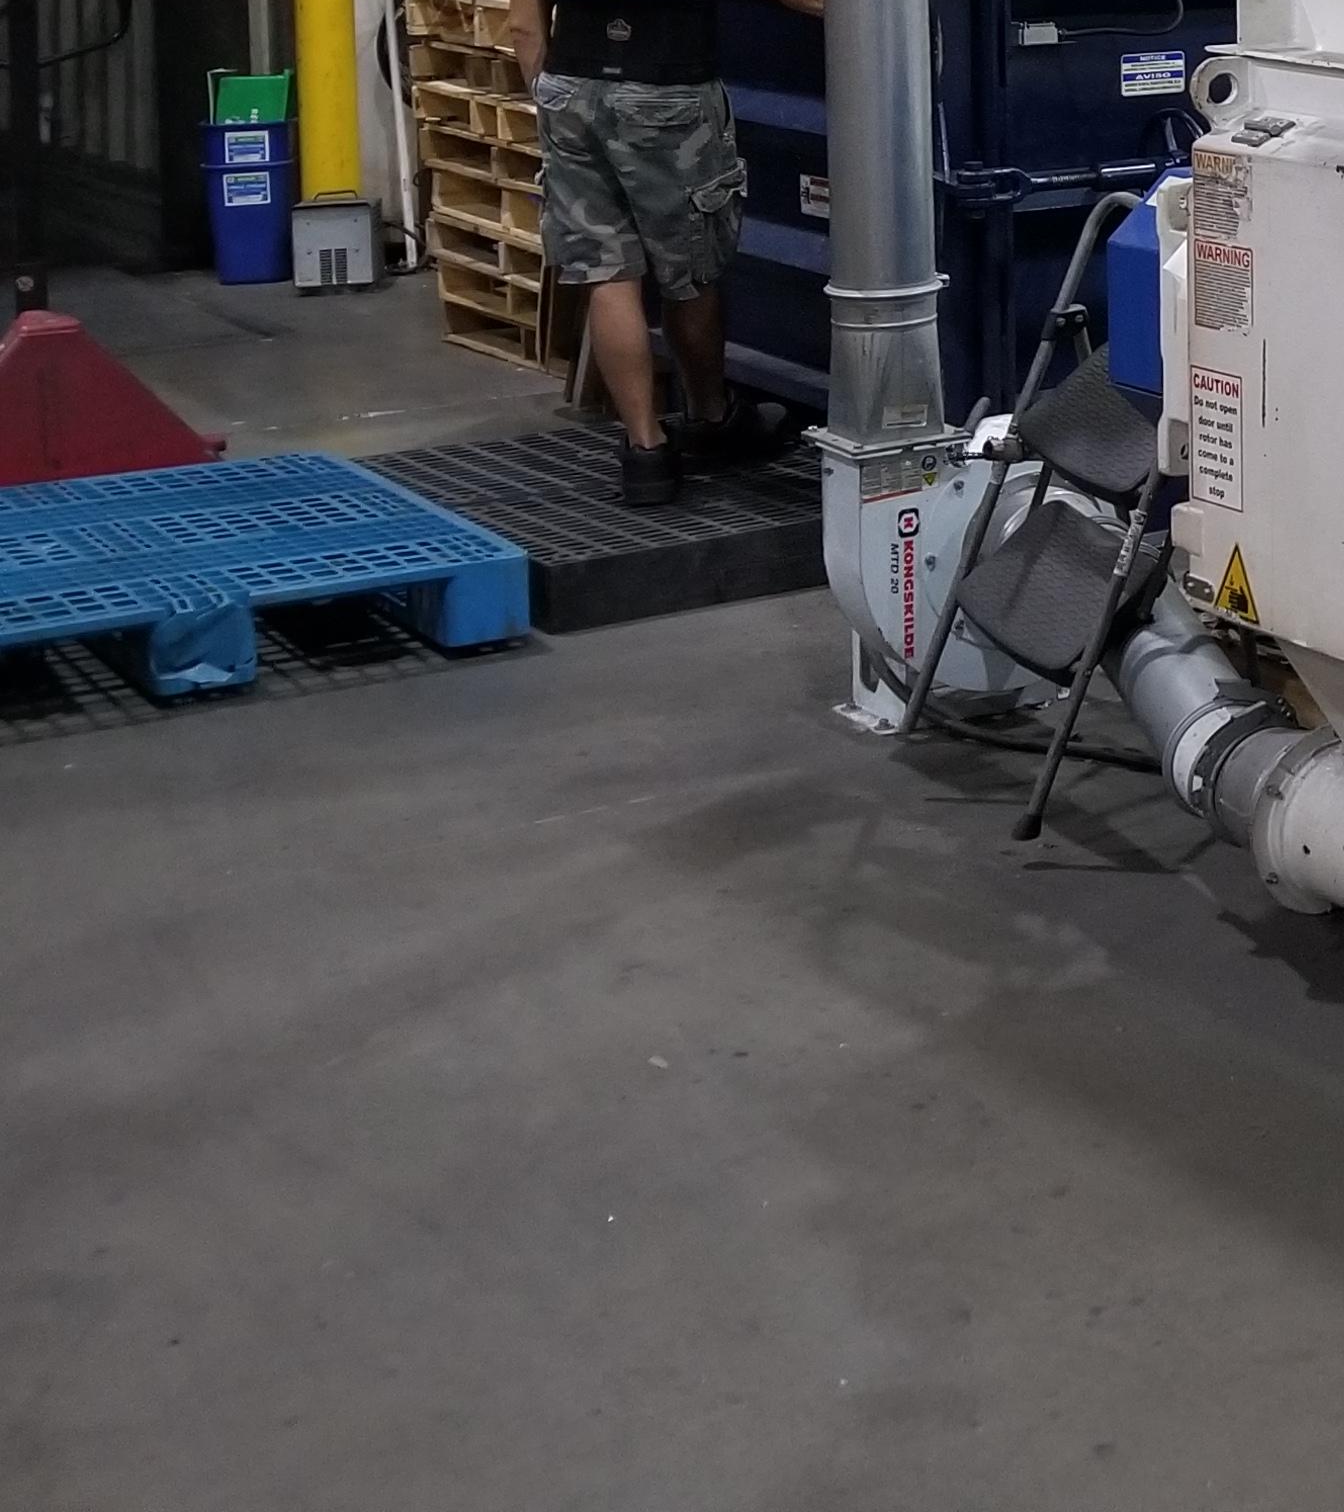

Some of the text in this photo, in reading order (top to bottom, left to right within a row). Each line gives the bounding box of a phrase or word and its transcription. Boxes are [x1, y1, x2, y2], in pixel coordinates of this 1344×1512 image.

[1135, 71, 1171, 80] AVISO
[1195, 152, 1234, 171] WARNI
[1196, 242, 1250, 269] WARNING
[1193, 373, 1240, 399] CAUTION
[1194, 395, 1238, 416] Do not open
[1198, 416, 1234, 433] door until
[1199, 433, 1233, 449] rotor has
[1198, 448, 1235, 466] come to a
[1199, 465, 1233, 483] complete
[1208, 486, 1226, 500] stop
[890, 543, 900, 595] MTD 20
[903, 539, 915, 659] KONGSKILDE
